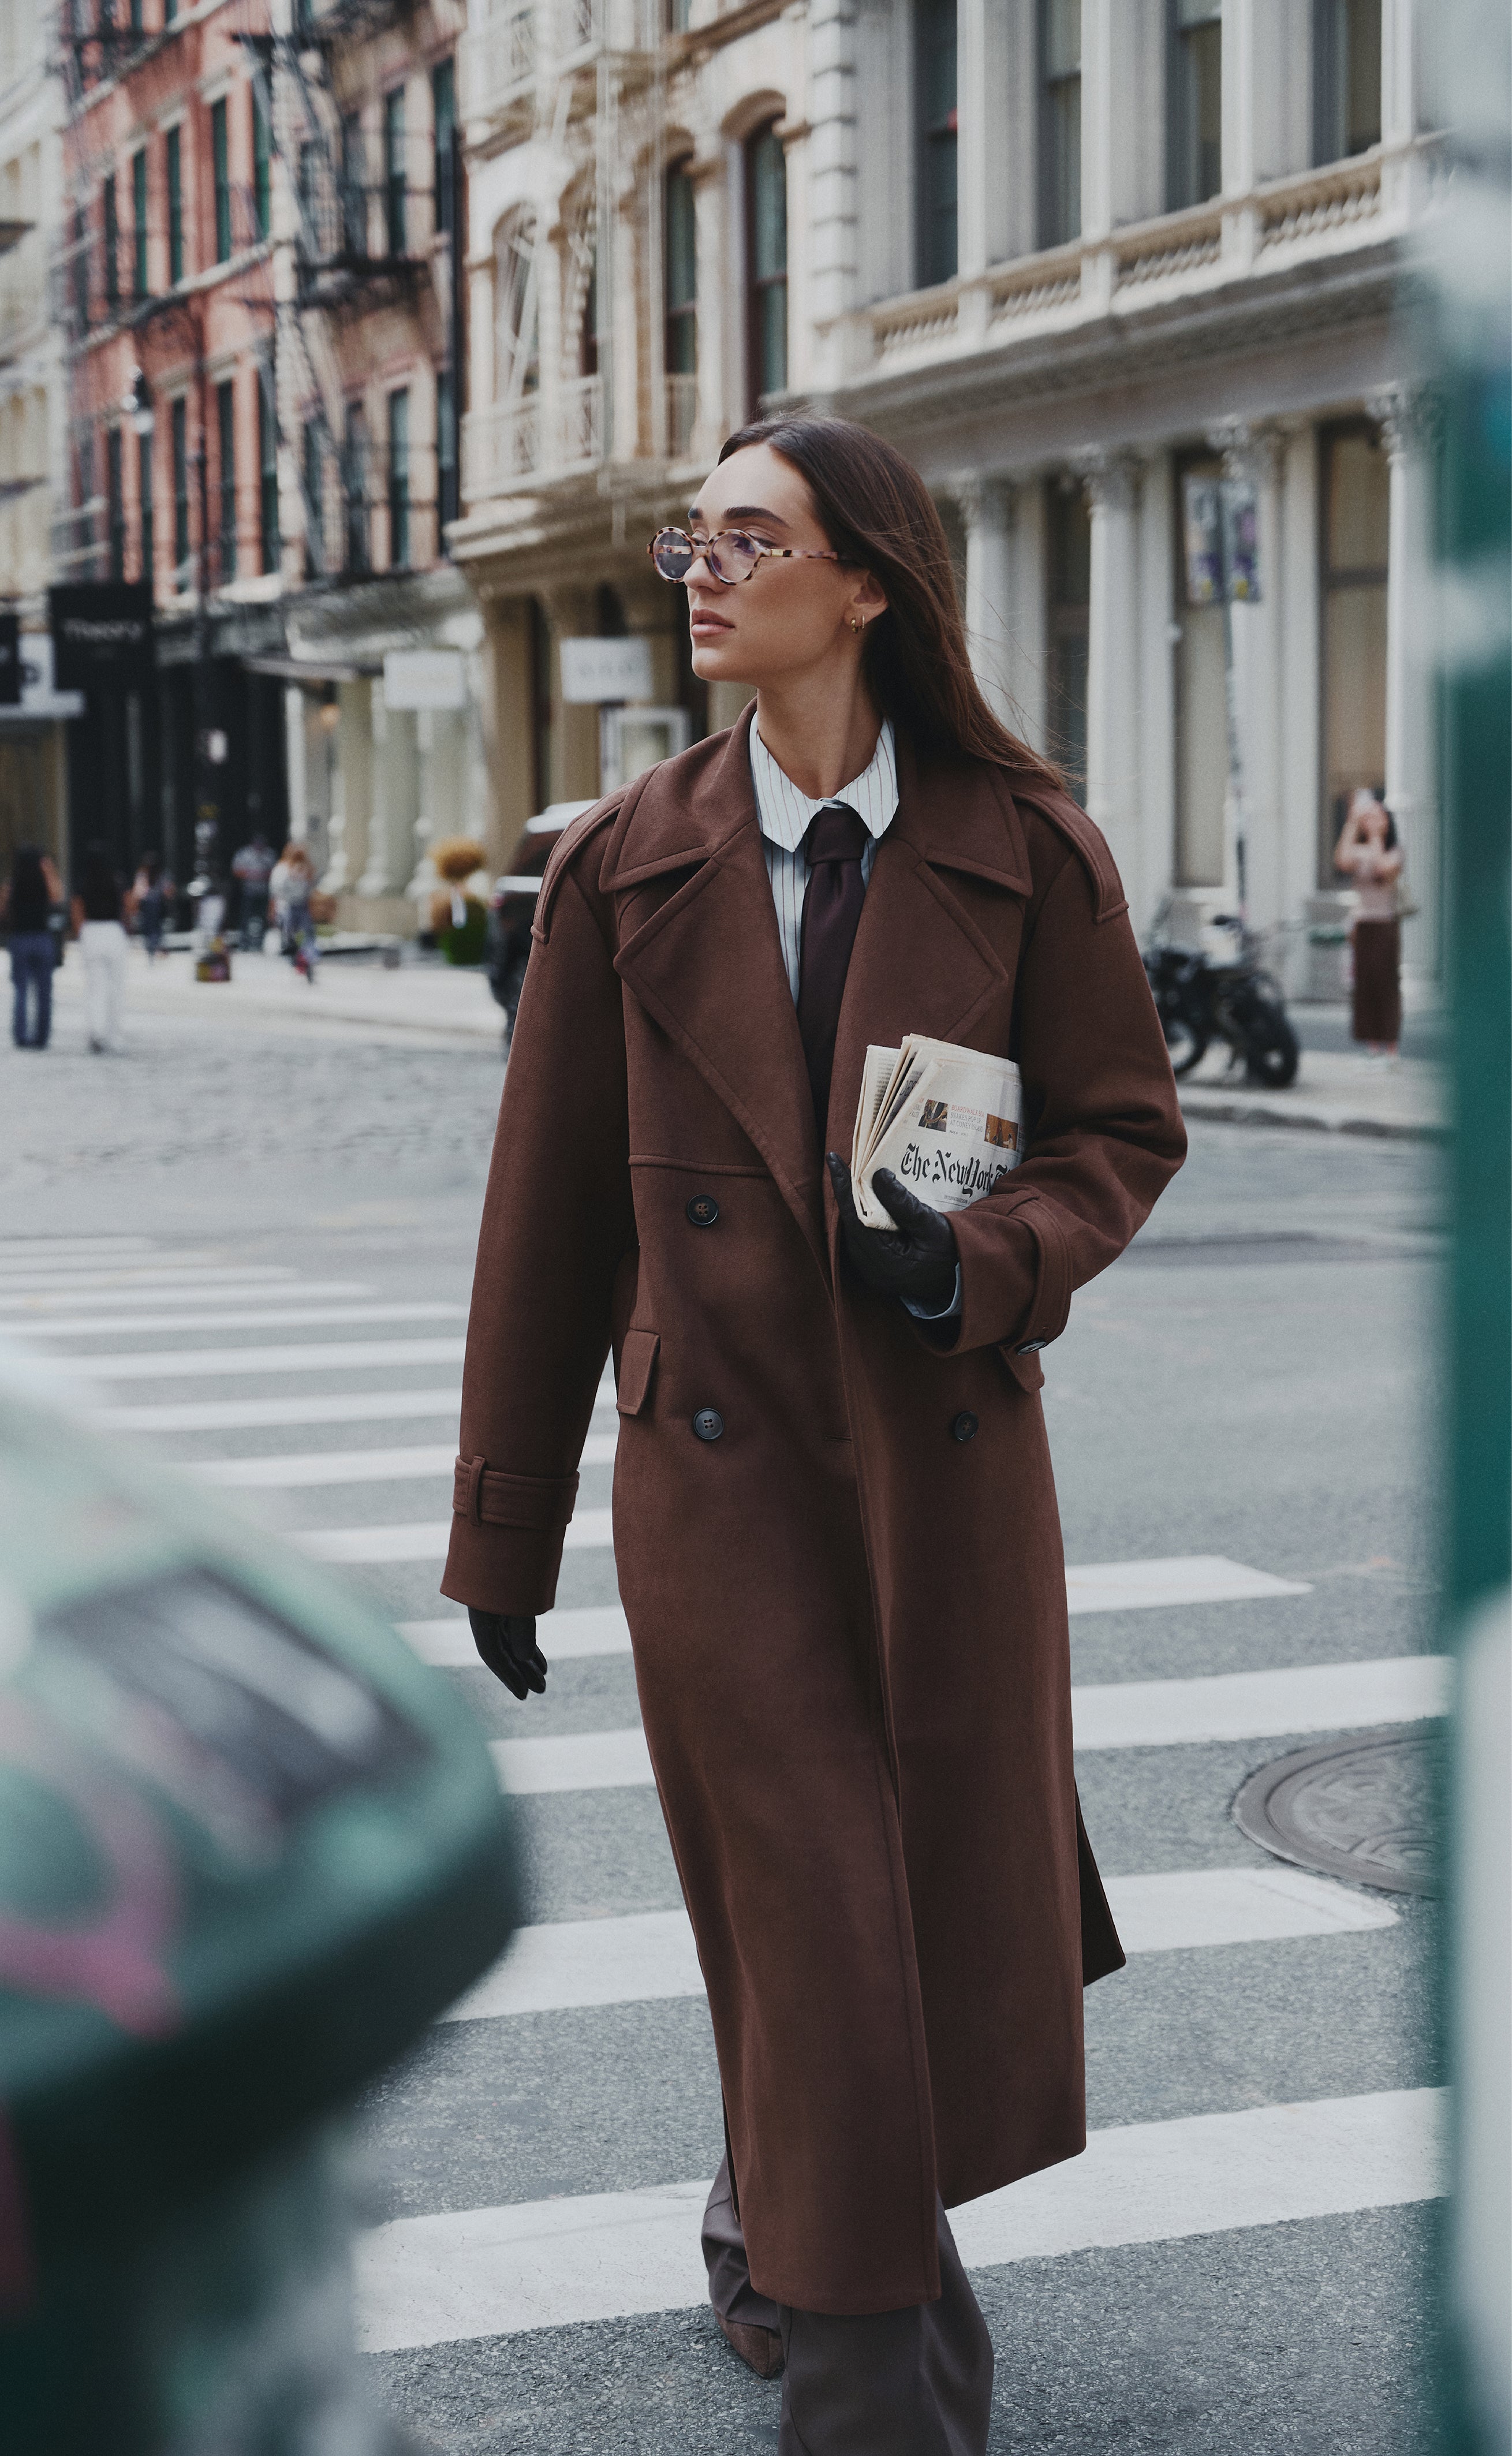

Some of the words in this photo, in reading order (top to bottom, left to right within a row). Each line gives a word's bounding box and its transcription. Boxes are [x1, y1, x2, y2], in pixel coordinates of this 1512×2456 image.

[951, 1104, 978, 1115] BOARDWALK
[950, 1112, 968, 1121] SNAKES
[901, 1143, 931, 1181] The
[932, 1149, 968, 1185] New
[962, 1156, 993, 1198] York
